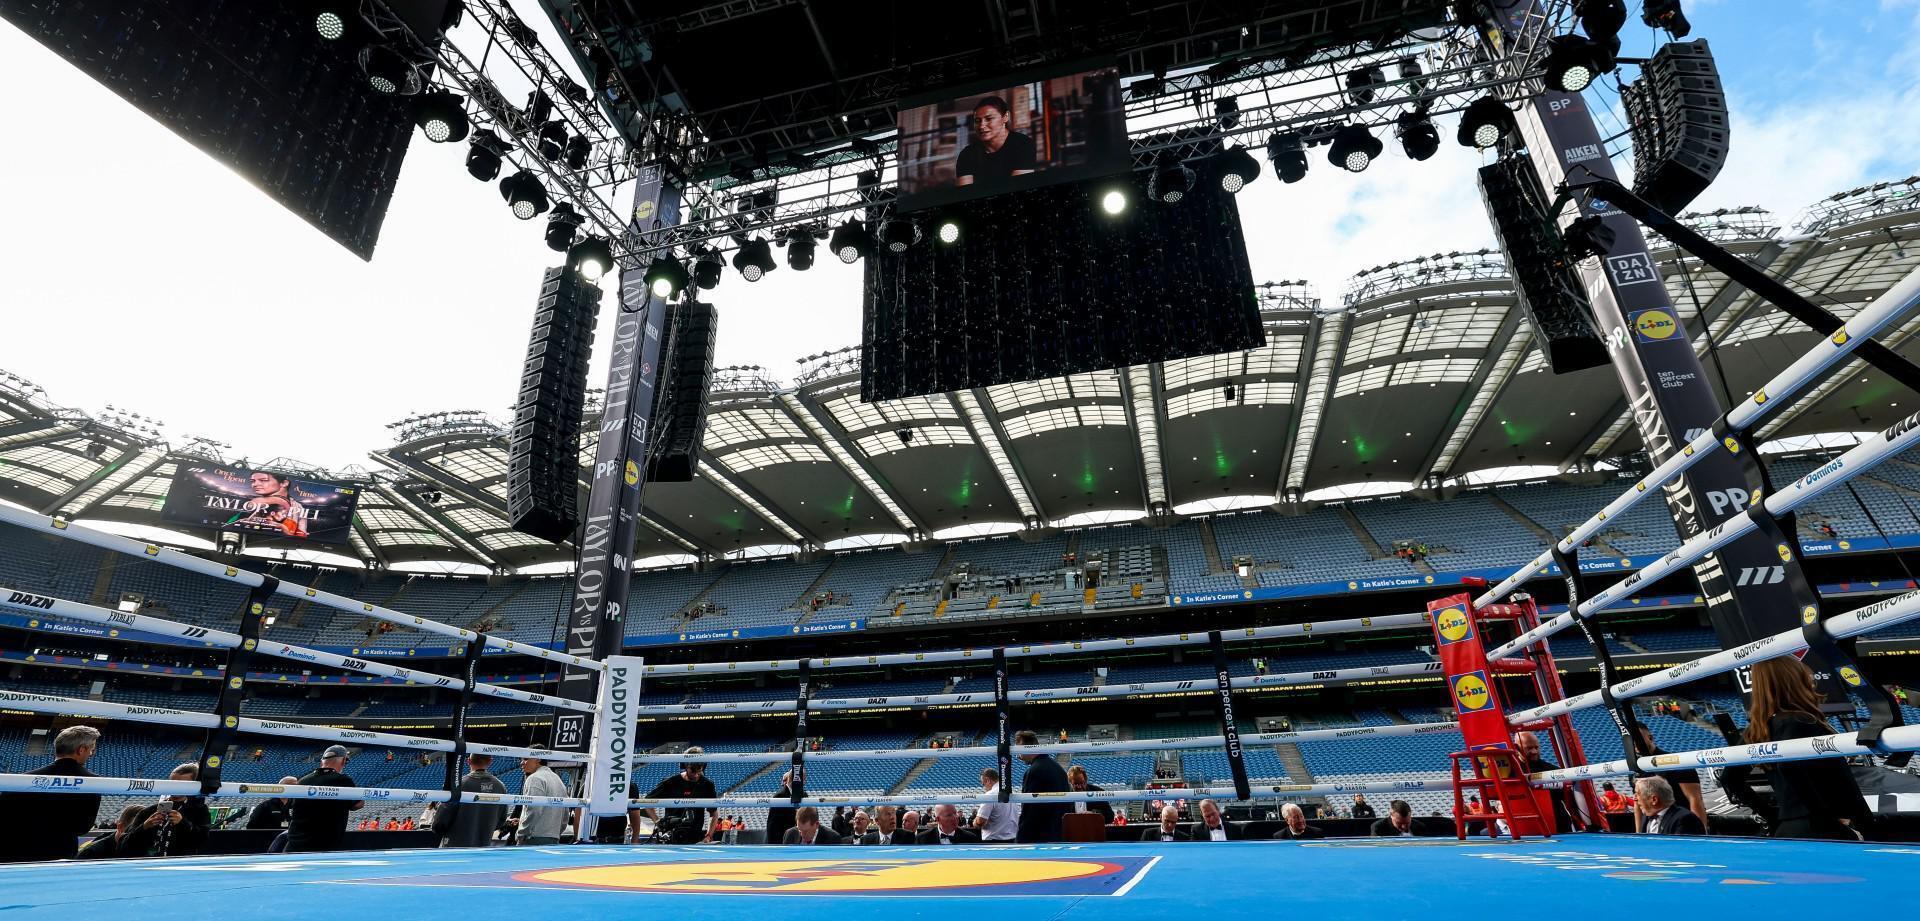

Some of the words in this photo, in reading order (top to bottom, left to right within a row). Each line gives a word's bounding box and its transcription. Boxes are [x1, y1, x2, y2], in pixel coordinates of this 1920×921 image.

[1549, 98, 1571, 113] BP
[1565, 143, 1600, 160] AIKEN
[1619, 258, 1641, 270] DA
[1624, 269, 1646, 280] ZN
[1657, 370, 1675, 379] ten
[1662, 380, 1684, 389] club
[1885, 410, 1920, 442] DAZ
[1805, 458, 1844, 485] Domino's
[204, 495, 270, 514] TAYLOR
[1803, 543, 1832, 551] Corner
[573, 508, 613, 613] TAYLOR
[1589, 562, 1616, 570] Corner
[1371, 580, 1396, 588] Katie's
[1395, 578, 1420, 586] Corner
[7, 592, 56, 610] DAZN
[1186, 595, 1194, 603] In
[1195, 593, 1218, 602] Katie's
[1219, 592, 1239, 601] Corner
[53, 623, 79, 632] Katie's
[80, 626, 105, 636] Corner
[810, 624, 828, 632] Katie's
[1439, 618, 1466, 631] LIDL
[287, 650, 317, 661] Domino's
[342, 658, 367, 670] DAZN
[1312, 671, 1337, 680] DAZN
[1458, 686, 1486, 698] LIDL
[1219, 670, 1228, 688] ten
[1227, 731, 1240, 758] club
[562, 719, 579, 731] DA
[1609, 707, 1630, 736] EVERLAST
[562, 731, 578, 744] ZN
[1758, 743, 1778, 756] ALP
[51, 776, 84, 787] ALP
[126, 779, 155, 792] EVERLAST
[1404, 781, 1425, 789] ALP
[372, 790, 390, 798] ALP
